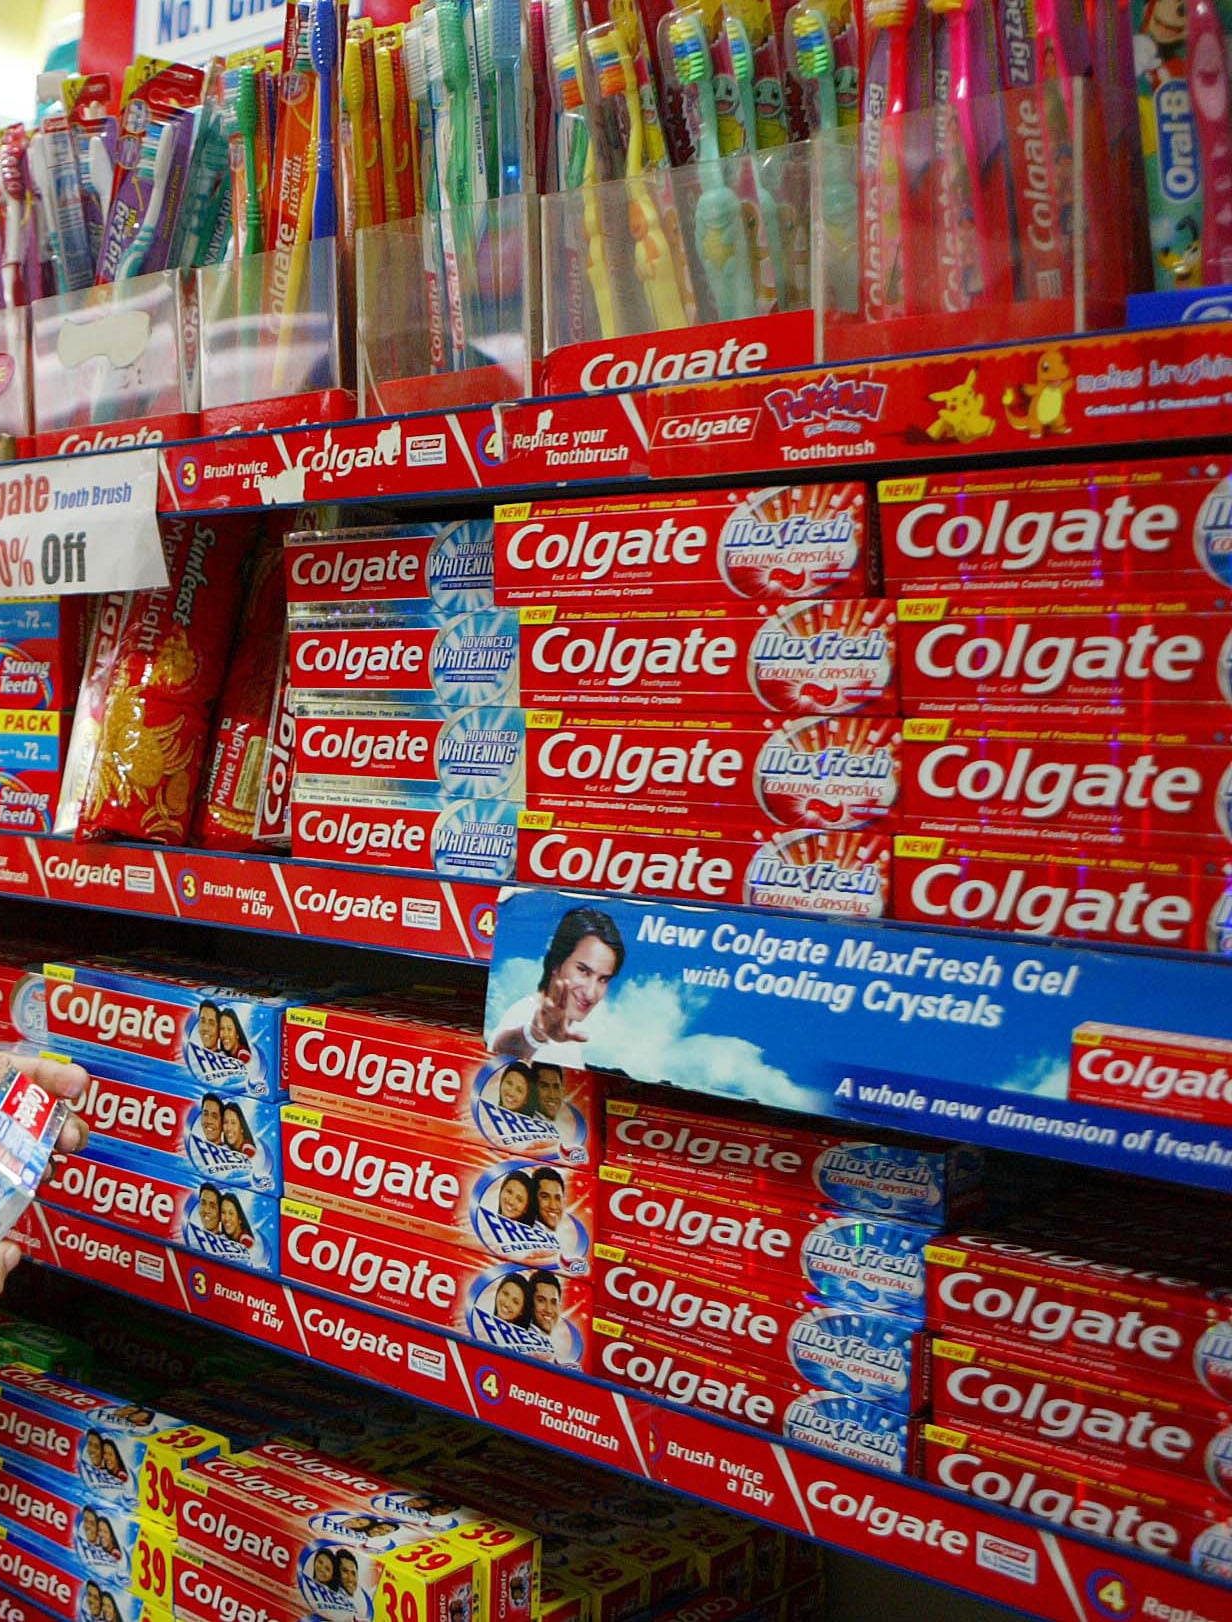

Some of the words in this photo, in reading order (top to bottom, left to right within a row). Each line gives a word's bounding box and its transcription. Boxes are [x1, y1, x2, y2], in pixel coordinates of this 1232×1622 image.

[1161, 89, 1195, 191] Oral-B
[280, 158, 293, 200] SUPER
[580, 338, 768, 392] Colgate
[1076, 363, 1144, 393] makes
[512, 429, 569, 451] Replace
[572, 428, 608, 448] your
[661, 415, 753, 442] Colgate
[545, 445, 629, 466] Toothbrush
[780, 440, 877, 462] Toothbrush
[203, 464, 235, 479] Brush
[237, 460, 268, 476] twice
[242, 477, 251, 489] a
[53, 489, 90, 511] Tooth
[91, 482, 132, 506] Brush
[499, 506, 528, 519] NEW!
[41, 531, 87, 586] Off
[291, 550, 420, 593] Colgate
[171, 521, 218, 628] Sunfeast
[25, 610, 41, 629] 72
[138, 589, 168, 651] Light
[525, 609, 553, 623] NEW!
[904, 603, 939, 616] NEW!
[459, 635, 513, 650] ADVANCED
[754, 628, 886, 662] MaxFresh
[1, 656, 51, 679] Strong
[295, 638, 423, 681] Colgate
[433, 648, 511, 670] WHITENING
[0, 675, 38, 696] Teeth
[4, 714, 53, 732] PACK
[530, 713, 559, 726] NEW!
[908, 722, 945, 735] NEW!
[22, 742, 40, 761] 72
[301, 725, 429, 768] Colgate
[439, 739, 516, 763] WHITENING
[465, 730, 518, 743] ADVANCED
[760, 745, 894, 779] MaxFresh
[215, 759, 237, 806] Marie
[0, 787, 50, 810] Strong
[298, 810, 425, 854] Colgate
[434, 829, 512, 857] WHITENING
[462, 821, 514, 836] ADVANCED
[901, 839, 938, 853] NEW!
[750, 856, 880, 894] MaxFresh
[203, 881, 233, 898] Brush
[236, 885, 267, 902] twice
[295, 885, 397, 922] Colgate
[242, 903, 249, 914] a
[252, 902, 273, 919] Day
[637, 914, 706, 949] New
[712, 923, 830, 965] Colgate
[835, 938, 1003, 988] MaxFresh
[1012, 959, 1080, 997] Gel
[682, 966, 731, 989] with
[734, 962, 857, 1013] Cooling
[863, 979, 1005, 1028] Crystals
[49, 984, 176, 1046] Colgate
[295, 1030, 461, 1104] Colgate
[486, 1104, 558, 1136] FRESH
[834, 1077, 854, 1099] A
[859, 1084, 928, 1111] whole
[930, 1098, 981, 1121] new
[987, 1104, 1116, 1146] dimension
[1122, 1129, 1152, 1151] of
[289, 1130, 460, 1208] Colgate
[823, 1150, 933, 1185] MaxFresh
[486, 1210, 560, 1246] FRESH
[287, 1223, 456, 1308] Colgate
[805, 1232, 920, 1278] MaxFresh
[929, 1250, 961, 1266] NEW!
[214, 1282, 245, 1305] Brush
[247, 1295, 277, 1316] twice
[251, 1310, 260, 1322] a
[262, 1310, 284, 1332] Day
[793, 1321, 904, 1372] MaxFresh
[938, 1343, 969, 1361] NEW!
[508, 1383, 563, 1414] Replace
[566, 1404, 601, 1427] your
[539, 1411, 620, 1451] Toothbrush
[788, 1402, 899, 1456] MaxFresh
[929, 1428, 963, 1447] NEW!
[667, 1441, 716, 1468] Brush
[719, 1458, 764, 1485] twice
[145, 1460, 175, 1517] 39
[726, 1478, 738, 1492] a
[742, 1481, 775, 1507] Day
[806, 1480, 970, 1556] Colgate
[459, 1521, 515, 1548] 39
[138, 1541, 166, 1598] 39
[395, 1543, 452, 1571] 39
